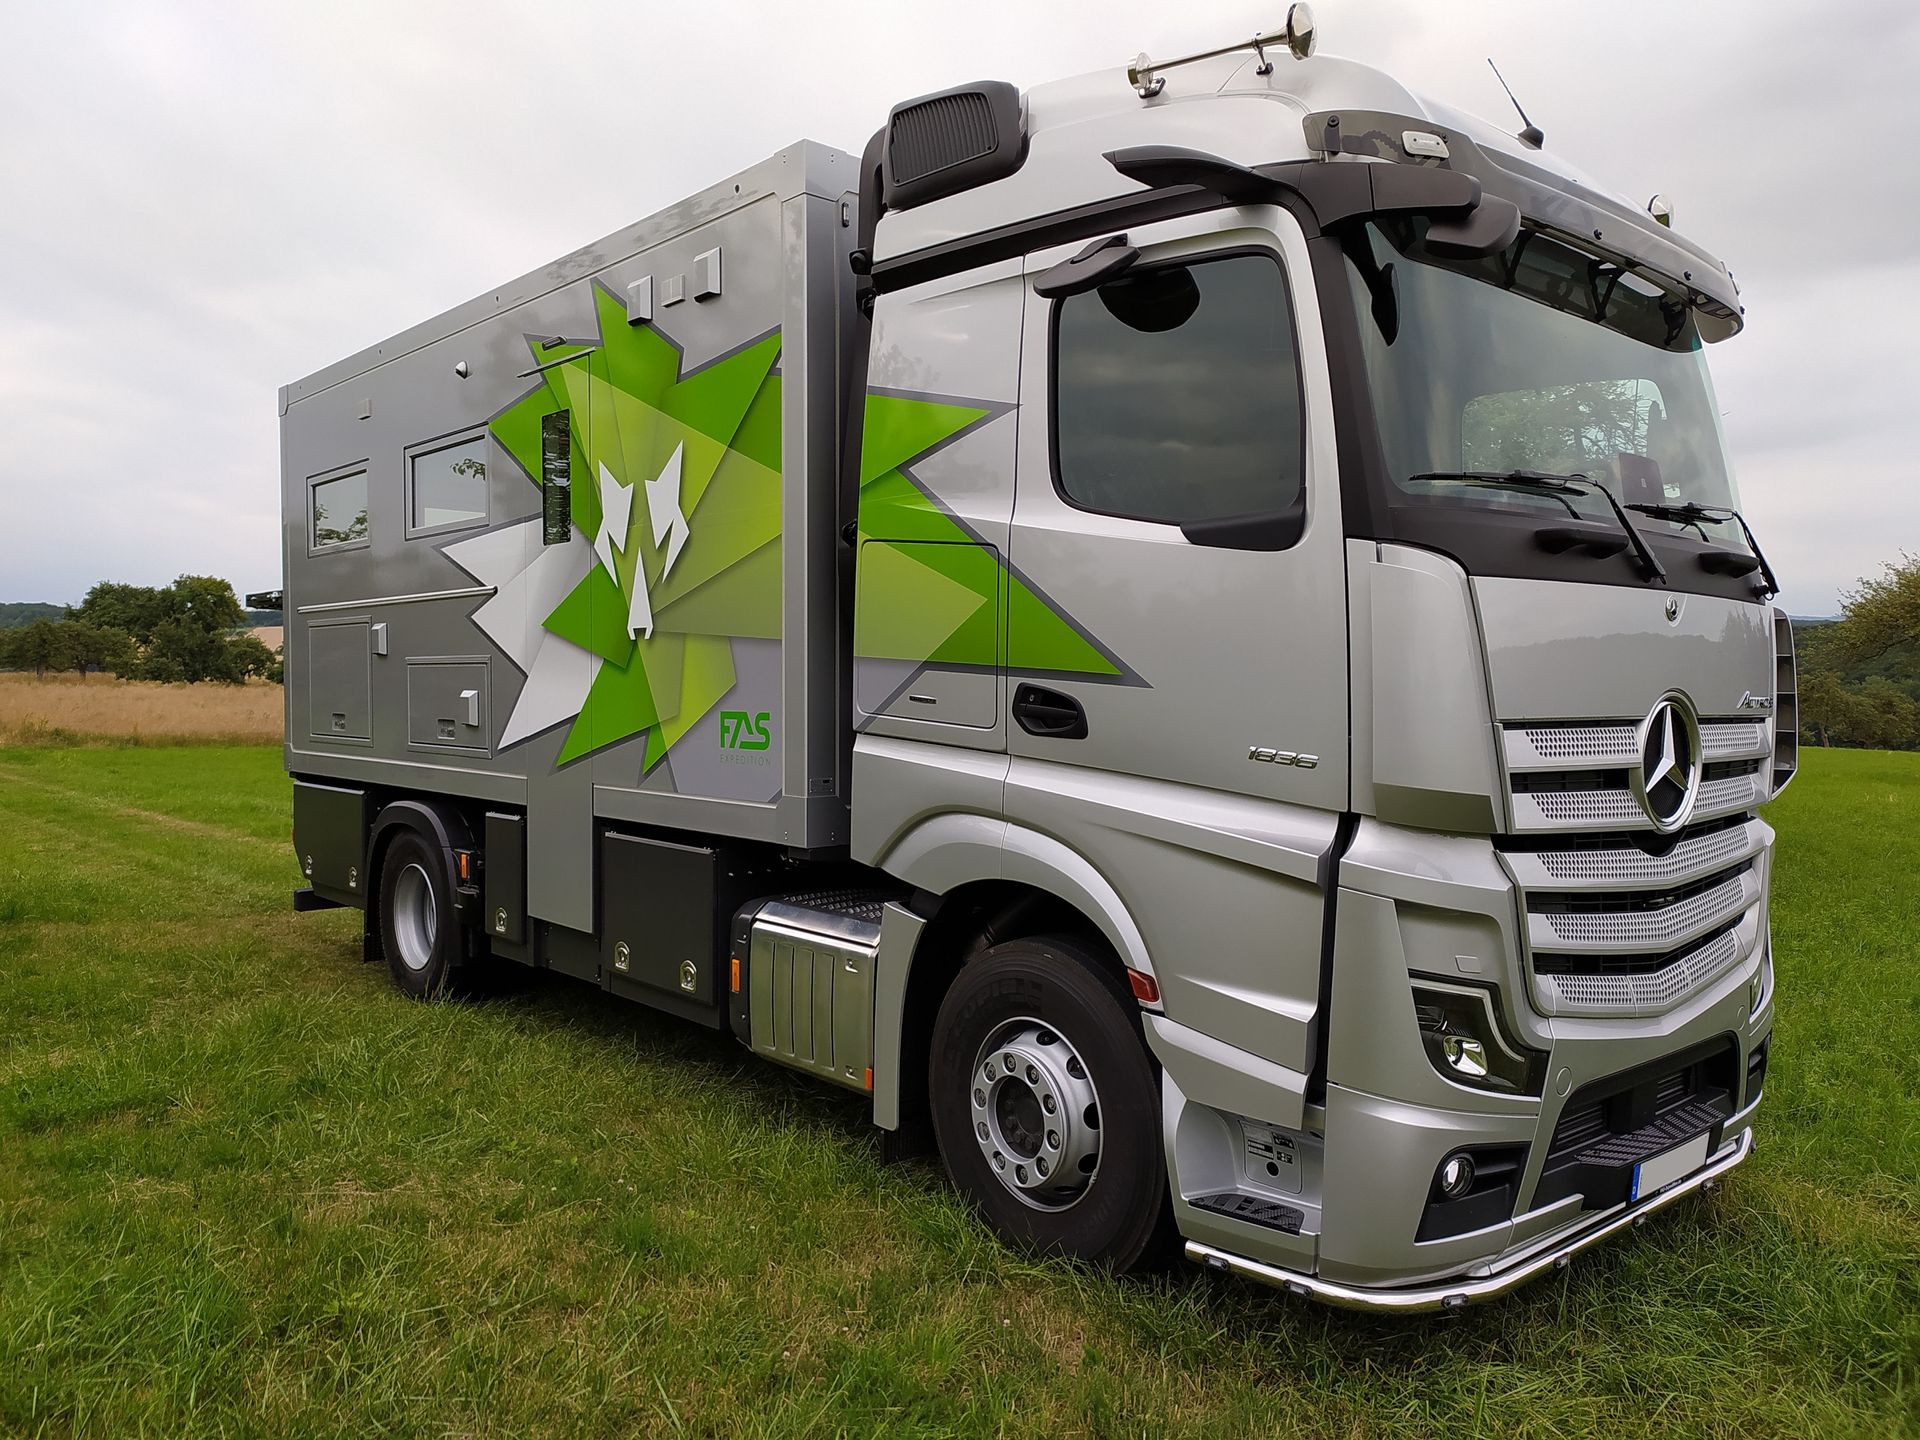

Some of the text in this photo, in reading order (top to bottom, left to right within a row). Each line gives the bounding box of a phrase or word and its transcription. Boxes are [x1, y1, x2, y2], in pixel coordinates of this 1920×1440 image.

[720, 711, 771, 751] FAS
[720, 753, 771, 767] EXPEDITION
[1248, 745, 1320, 769] 1836
